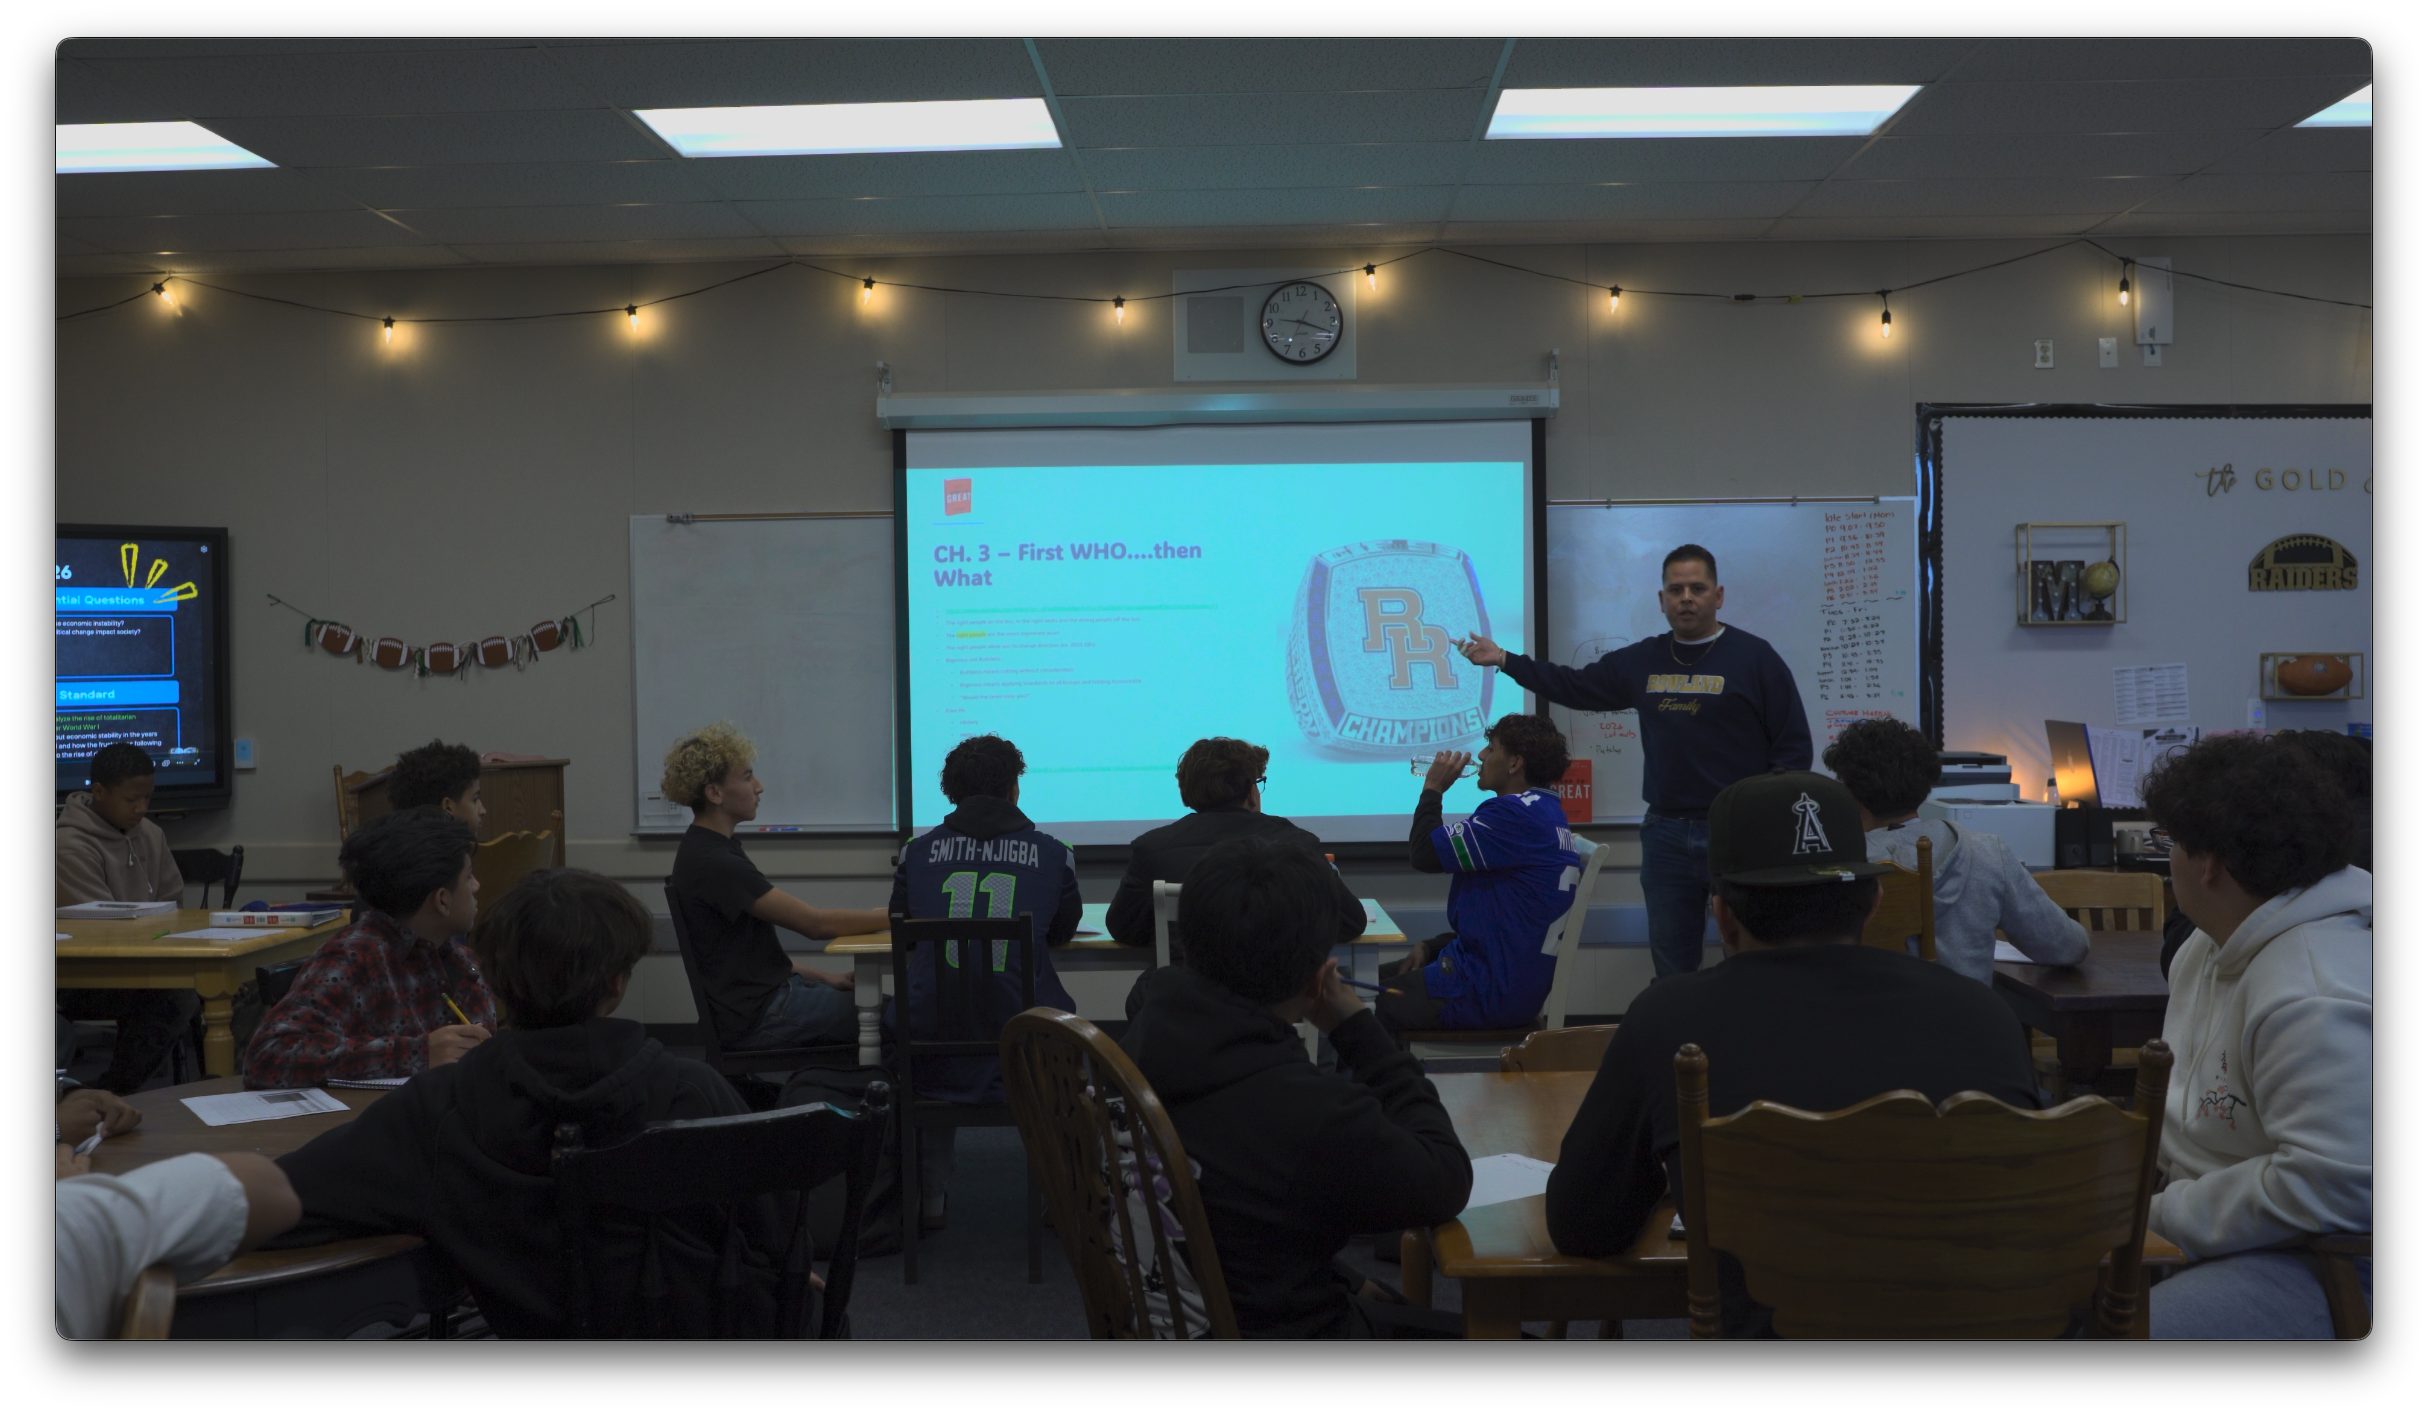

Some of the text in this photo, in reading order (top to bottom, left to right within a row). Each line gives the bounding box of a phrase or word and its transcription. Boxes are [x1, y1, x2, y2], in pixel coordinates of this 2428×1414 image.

[1282, 291, 1291, 302] 11
[1296, 286, 1307, 297] 12
[1313, 290, 1319, 301] 1
[1269, 302, 1279, 314] 10
[1324, 301, 1332, 312] 2
[1266, 318, 1273, 328] 9
[1330, 316, 1336, 327] 3
[1284, 344, 1291, 355] 7
[1299, 347, 1306, 358] 6
[1314, 343, 1321, 354] 5
[2256, 467, 2348, 491] GOLD
[946, 492, 971, 503] GREAT
[933, 543, 972, 563] CH.
[978, 544, 991, 562] 3
[1018, 542, 1065, 561] First
[933, 567, 993, 587] What
[2249, 566, 2359, 592] RAIDERS
[2024, 560, 2086, 622] M
[84, 595, 145, 606] Questions
[92, 619, 125, 628] instability?
[95, 628, 116, 636] impact
[116, 628, 141, 636] society?
[1646, 673, 1726, 695] ROWLAND
[61, 689, 116, 701] Standard
[1657, 697, 1702, 717] Family
[83, 723, 97, 731] War
[1339, 709, 1486, 745] CHAMPIONS
[66, 732, 98, 740] economic
[141, 731, 158, 739] years
[134, 739, 163, 747] following
[1791, 792, 1834, 854] A
[928, 836, 1040, 868] SMITH-NJIGBA
